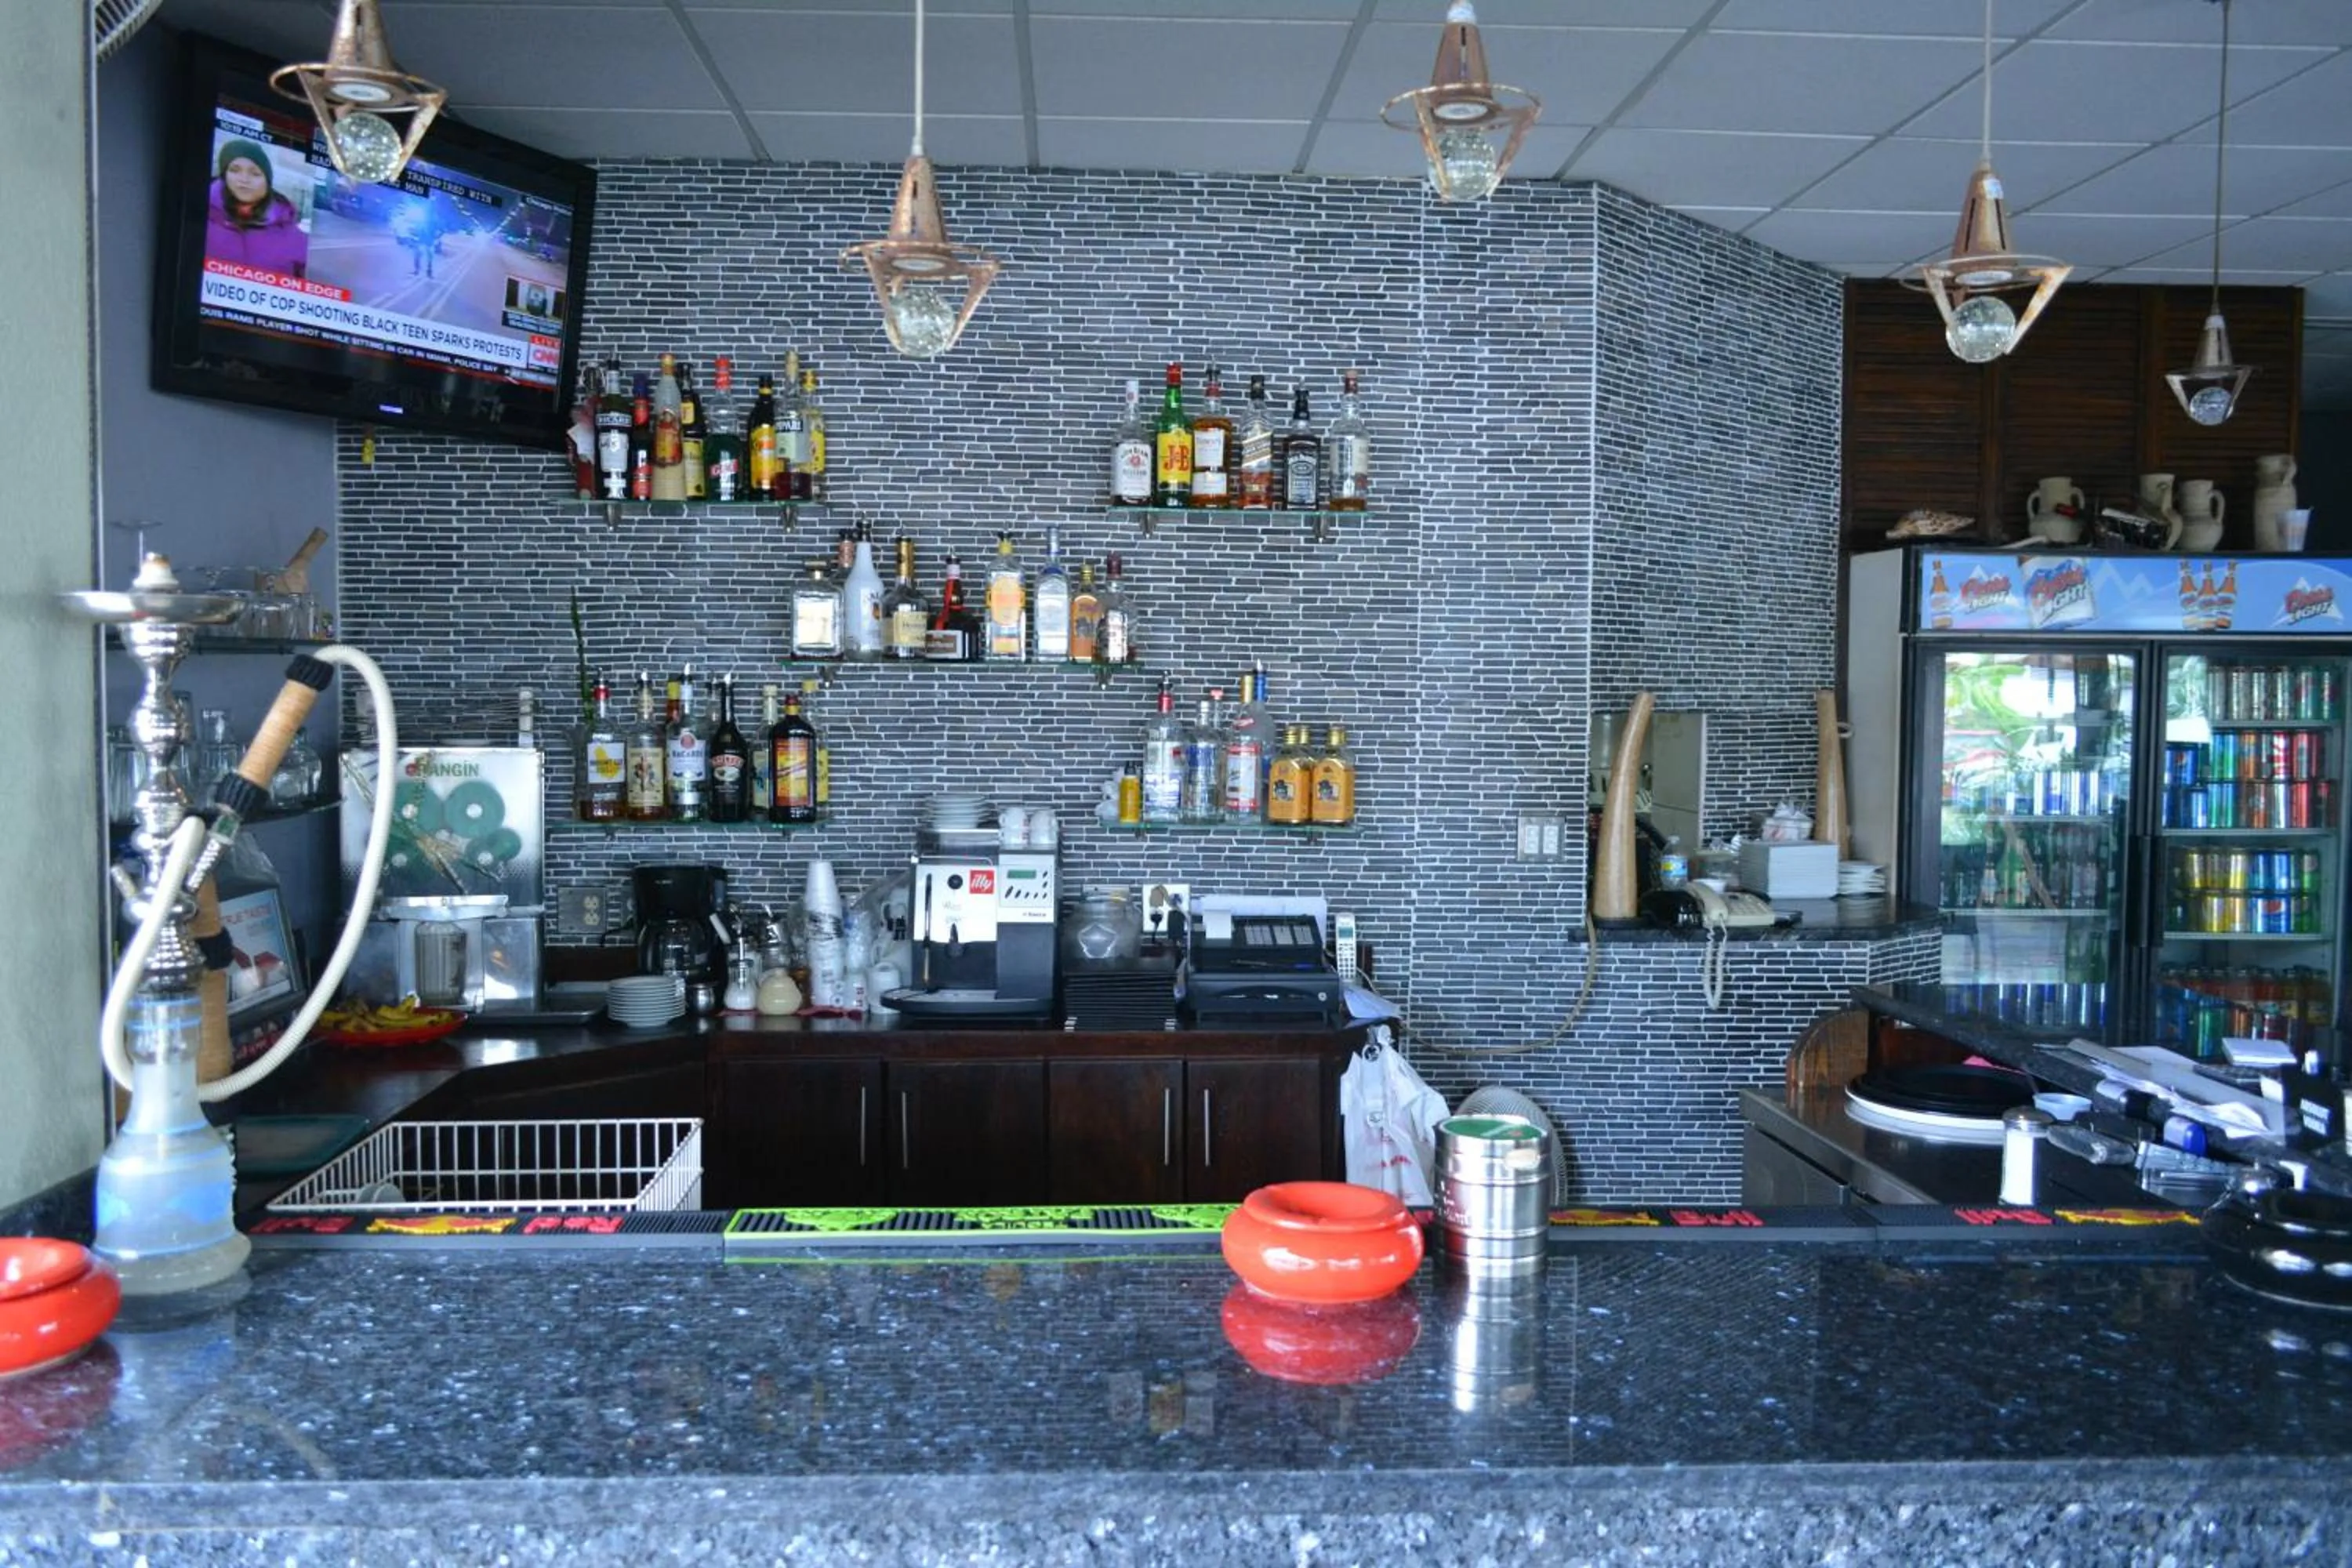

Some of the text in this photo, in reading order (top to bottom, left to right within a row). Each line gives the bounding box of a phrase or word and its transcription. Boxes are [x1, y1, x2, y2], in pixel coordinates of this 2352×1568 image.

[407, 171, 465, 195] TRANSPIRED
[470, 190, 492, 205] WITH
[208, 260, 341, 299] CHICAGO ON EDGE
[205, 280, 522, 361] VIDEO OF COP SHOOTING BLACK TEEN SPARKS PROTESTS
[256, 318, 292, 332] PLAYER
[294, 325, 318, 337] SHOT
[971, 874, 992, 891] illy
